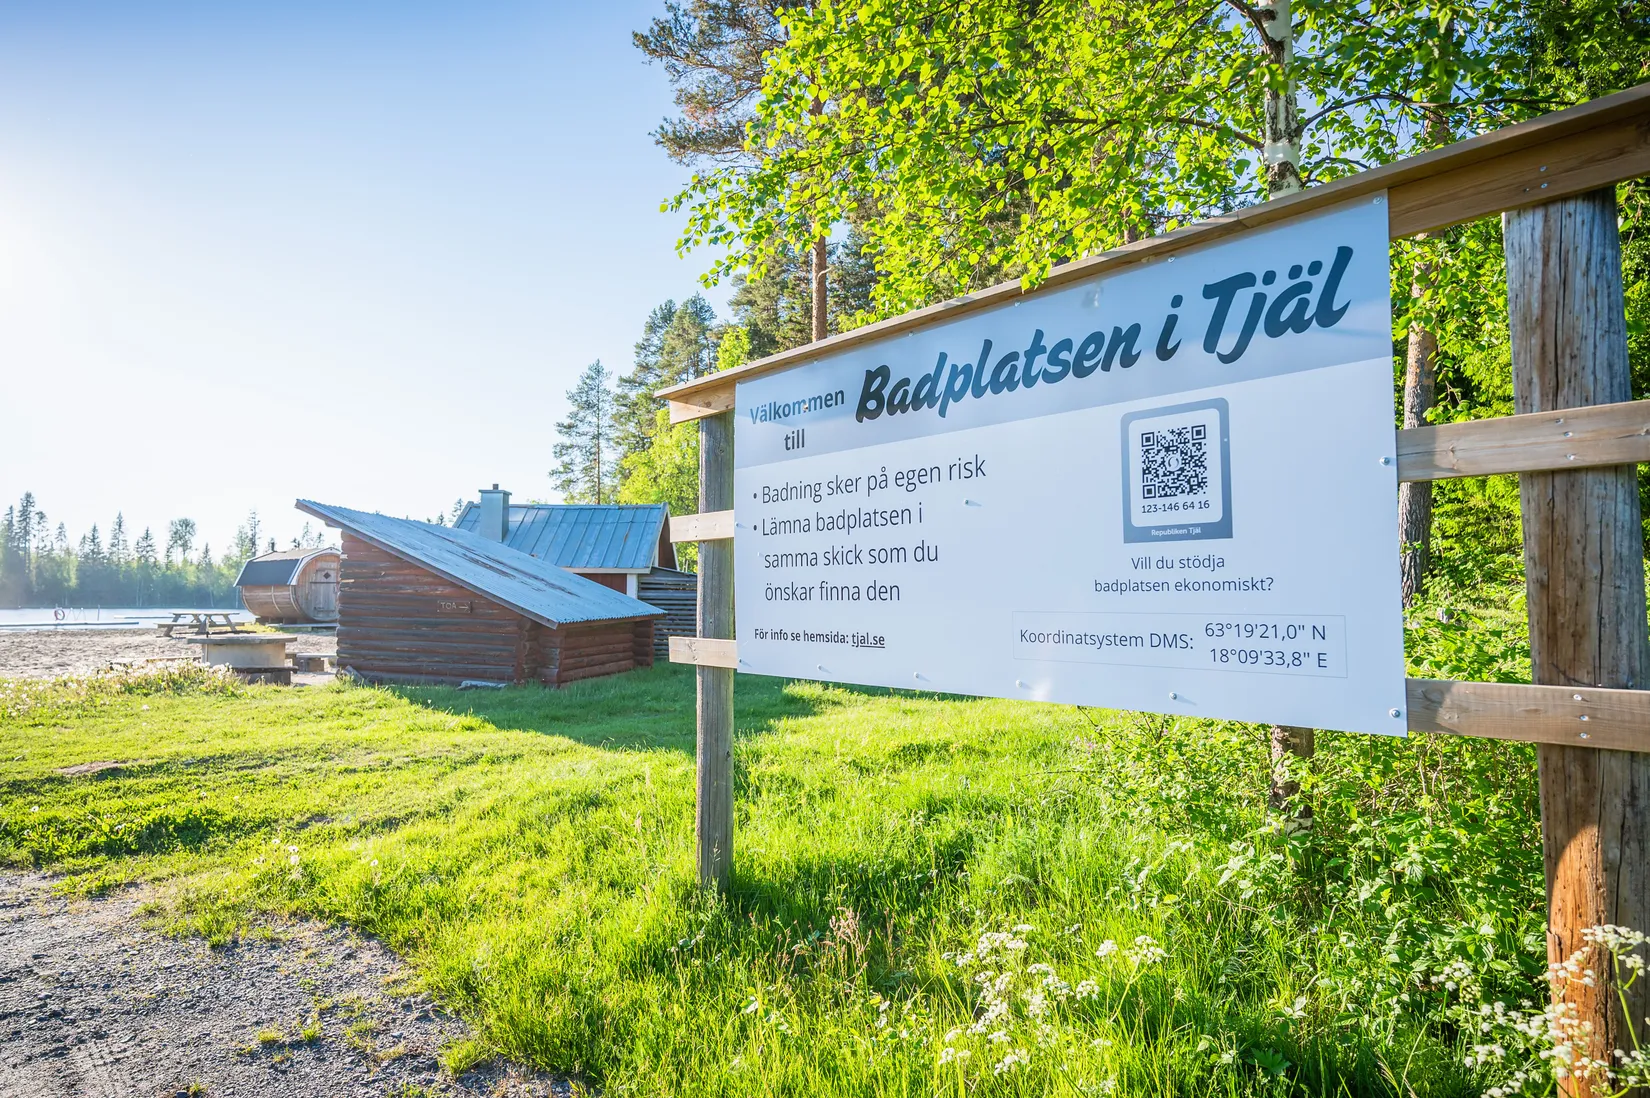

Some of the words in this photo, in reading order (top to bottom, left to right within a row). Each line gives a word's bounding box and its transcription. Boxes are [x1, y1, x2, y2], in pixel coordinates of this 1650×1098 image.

[856, 322, 1142, 423] Badplatsen
[1156, 295, 1183, 361] i
[1202, 245, 1354, 364] Tjäl
[750, 390, 844, 424] Välkommen
[784, 429, 804, 451] till
[763, 481, 822, 503] Badning
[827, 475, 861, 495] sker
[868, 466, 887, 497] på
[895, 465, 941, 491] egen
[949, 454, 986, 480] risk
[1142, 502, 1179, 513] 123-146
[1183, 501, 1195, 510] 64
[1198, 500, 1210, 509] 16
[763, 517, 810, 536] Lämna
[817, 508, 911, 535] badplatsen
[1151, 528, 1188, 537] Republiken
[1189, 526, 1202, 536] Tjäl
[765, 551, 818, 569] samma
[824, 544, 863, 566] skick
[869, 547, 906, 564] som
[914, 540, 939, 563] du
[1131, 557, 1151, 569] Vill
[1156, 556, 1173, 569] du
[1179, 554, 1224, 572] stödja
[765, 582, 814, 601] önskar
[819, 581, 860, 601] finna
[867, 580, 899, 601] den
[1095, 579, 1169, 595] badplatsen
[1175, 577, 1273, 591] ekonomiskt?
[440, 602, 457, 610] TOA
[755, 629, 768, 639] För
[771, 629, 788, 640] info
[791, 633, 800, 641] se
[804, 630, 848, 643] hemsida:
[852, 632, 885, 648] tjal.se
[1021, 630, 1143, 649] Koordinatsystem
[1150, 633, 1193, 649] DMS:
[1313, 625, 1325, 640] N
[1318, 653, 1327, 668] E
